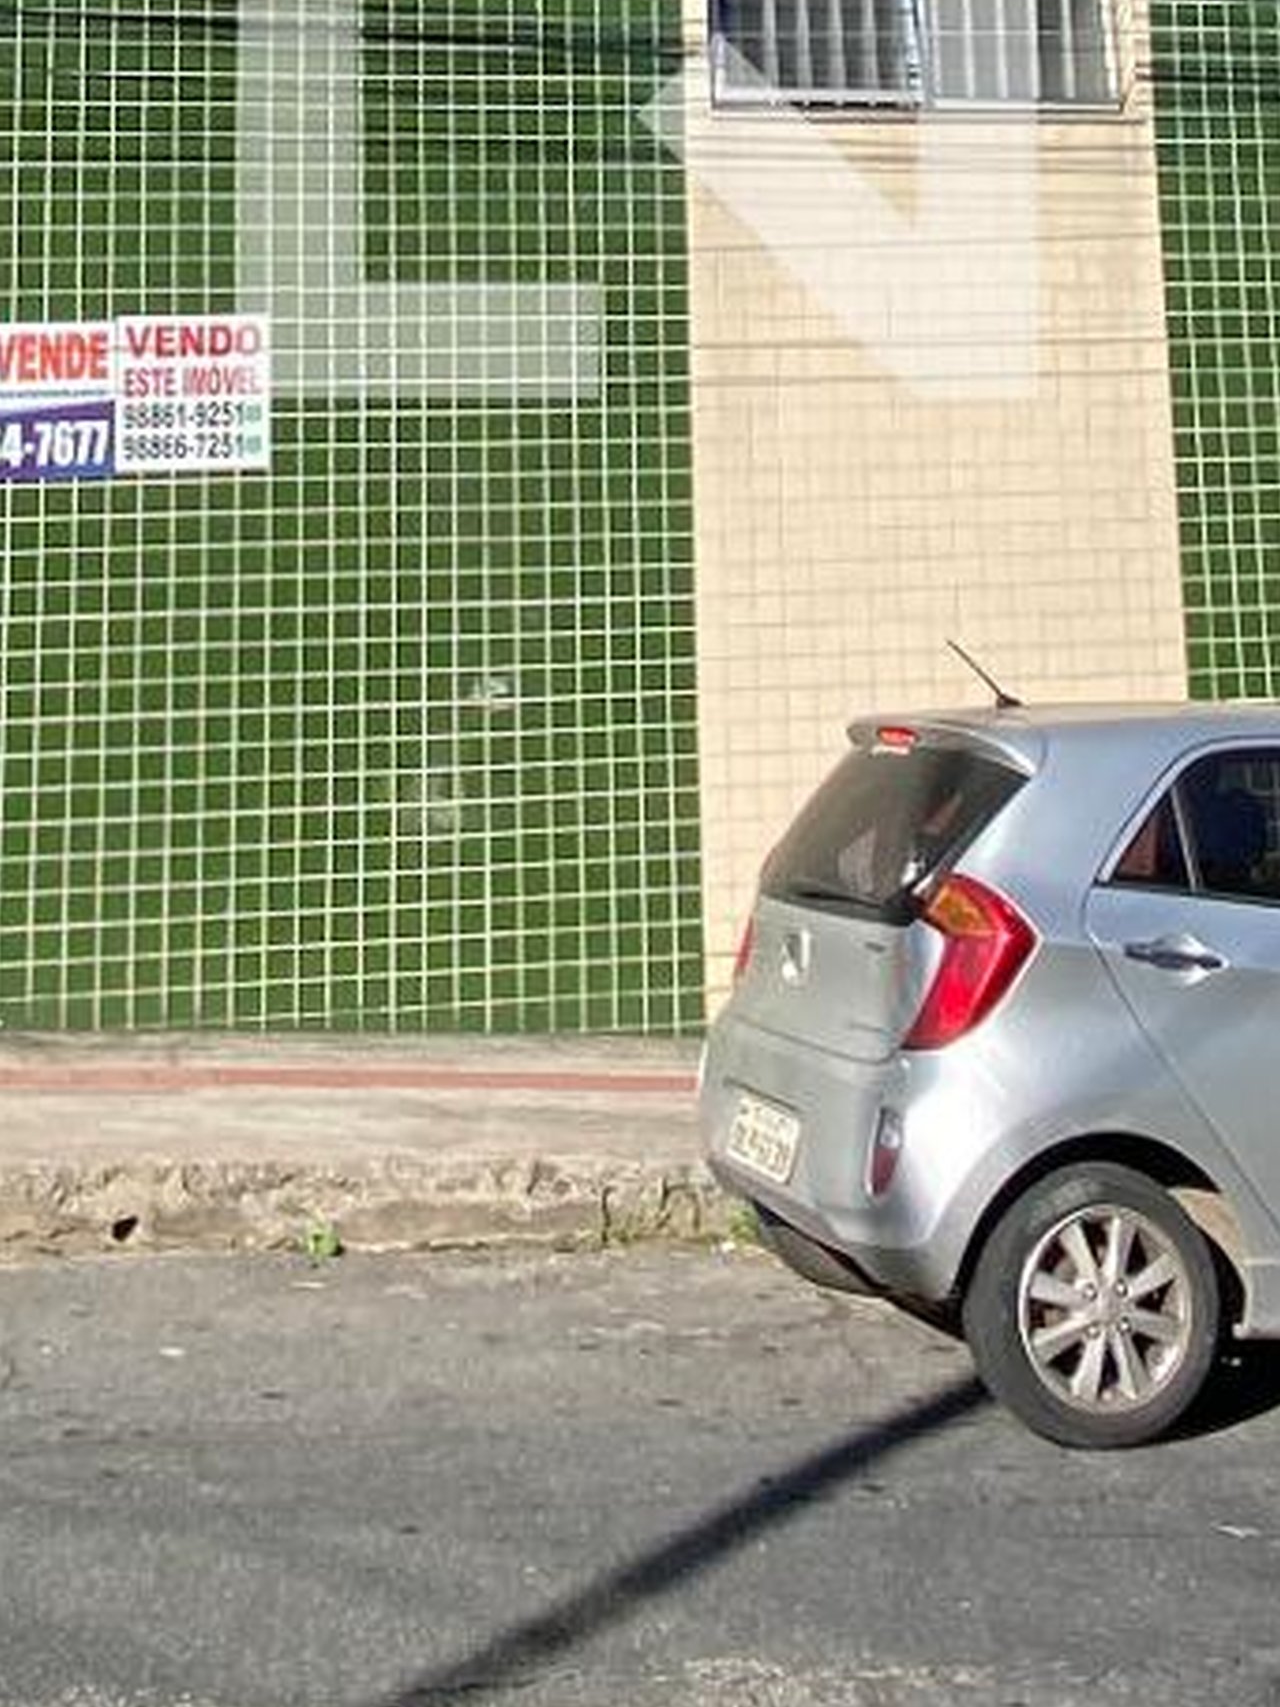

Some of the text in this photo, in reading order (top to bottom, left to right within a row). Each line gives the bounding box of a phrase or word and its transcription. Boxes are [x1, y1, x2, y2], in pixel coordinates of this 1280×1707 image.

[125, 324, 262, 358] VENDO
[124, 361, 262, 397] ESTE IMÓVEL
